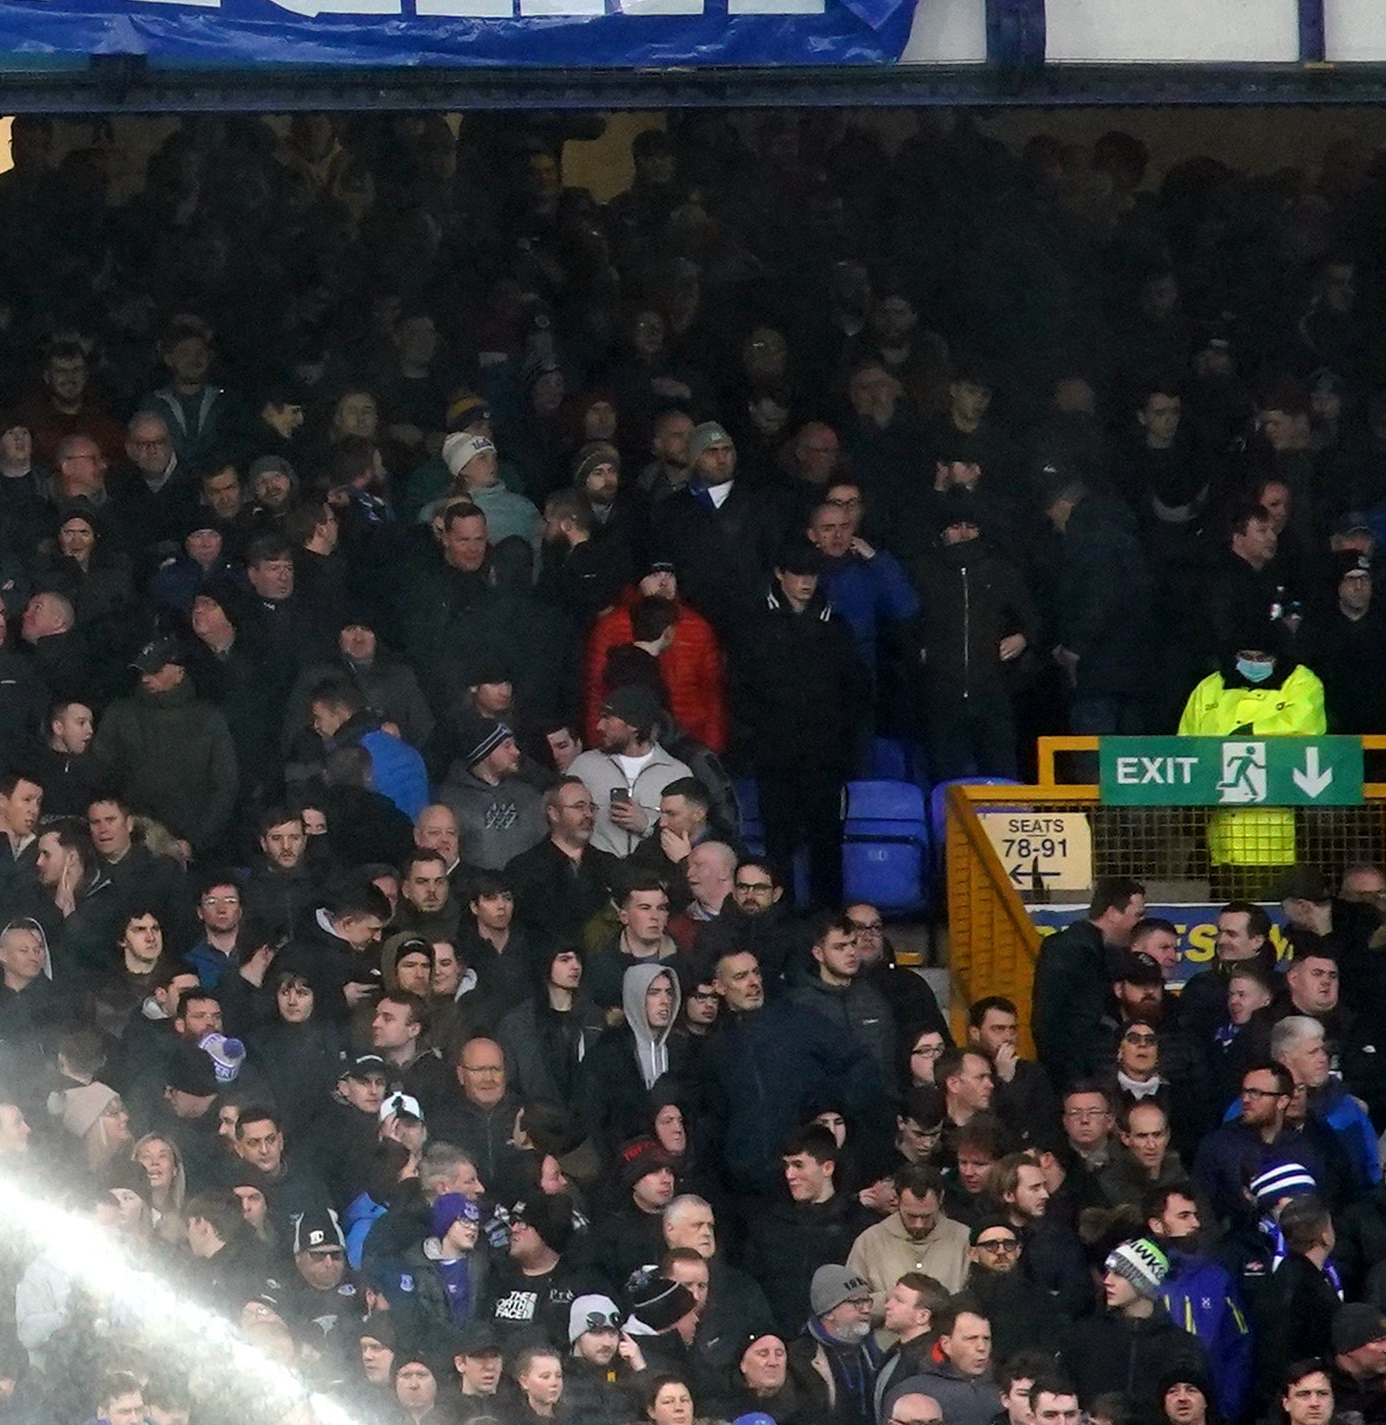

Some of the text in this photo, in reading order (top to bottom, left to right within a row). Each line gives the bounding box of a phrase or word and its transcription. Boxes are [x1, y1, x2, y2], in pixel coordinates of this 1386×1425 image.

[1116, 756, 1199, 785] EXIT
[1008, 818, 1065, 834] SEATS
[1001, 838, 1068, 859] 78-91
[510, 1290, 531, 1301] THE
